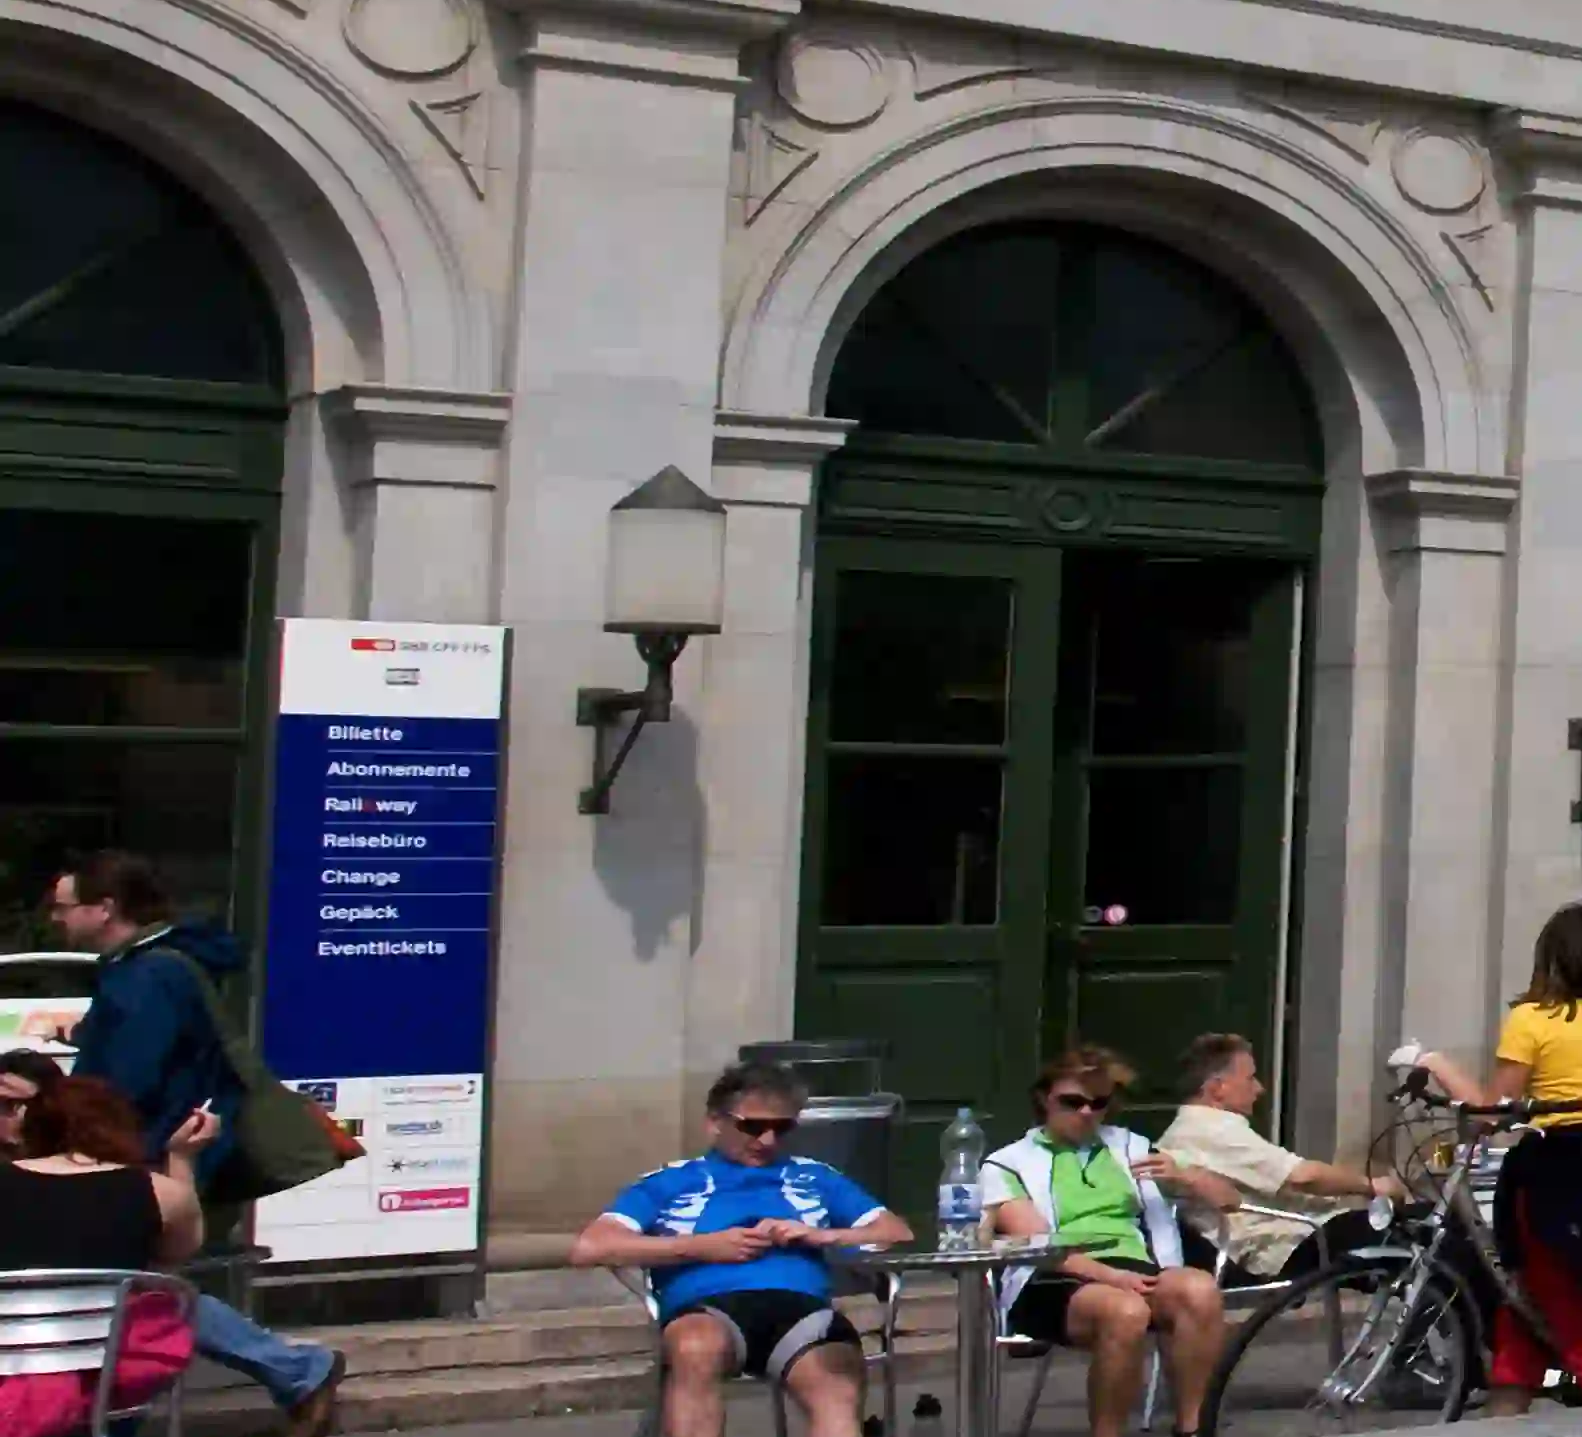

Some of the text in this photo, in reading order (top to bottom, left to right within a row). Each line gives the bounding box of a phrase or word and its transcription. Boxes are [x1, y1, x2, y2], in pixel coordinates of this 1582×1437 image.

[328, 725, 403, 741] Billette
[327, 761, 472, 778] Abonnemente
[323, 832, 427, 848] Reisebüro
[321, 869, 401, 887] Change
[319, 905, 399, 923] Gepäck
[318, 941, 447, 958] Eventtickets
